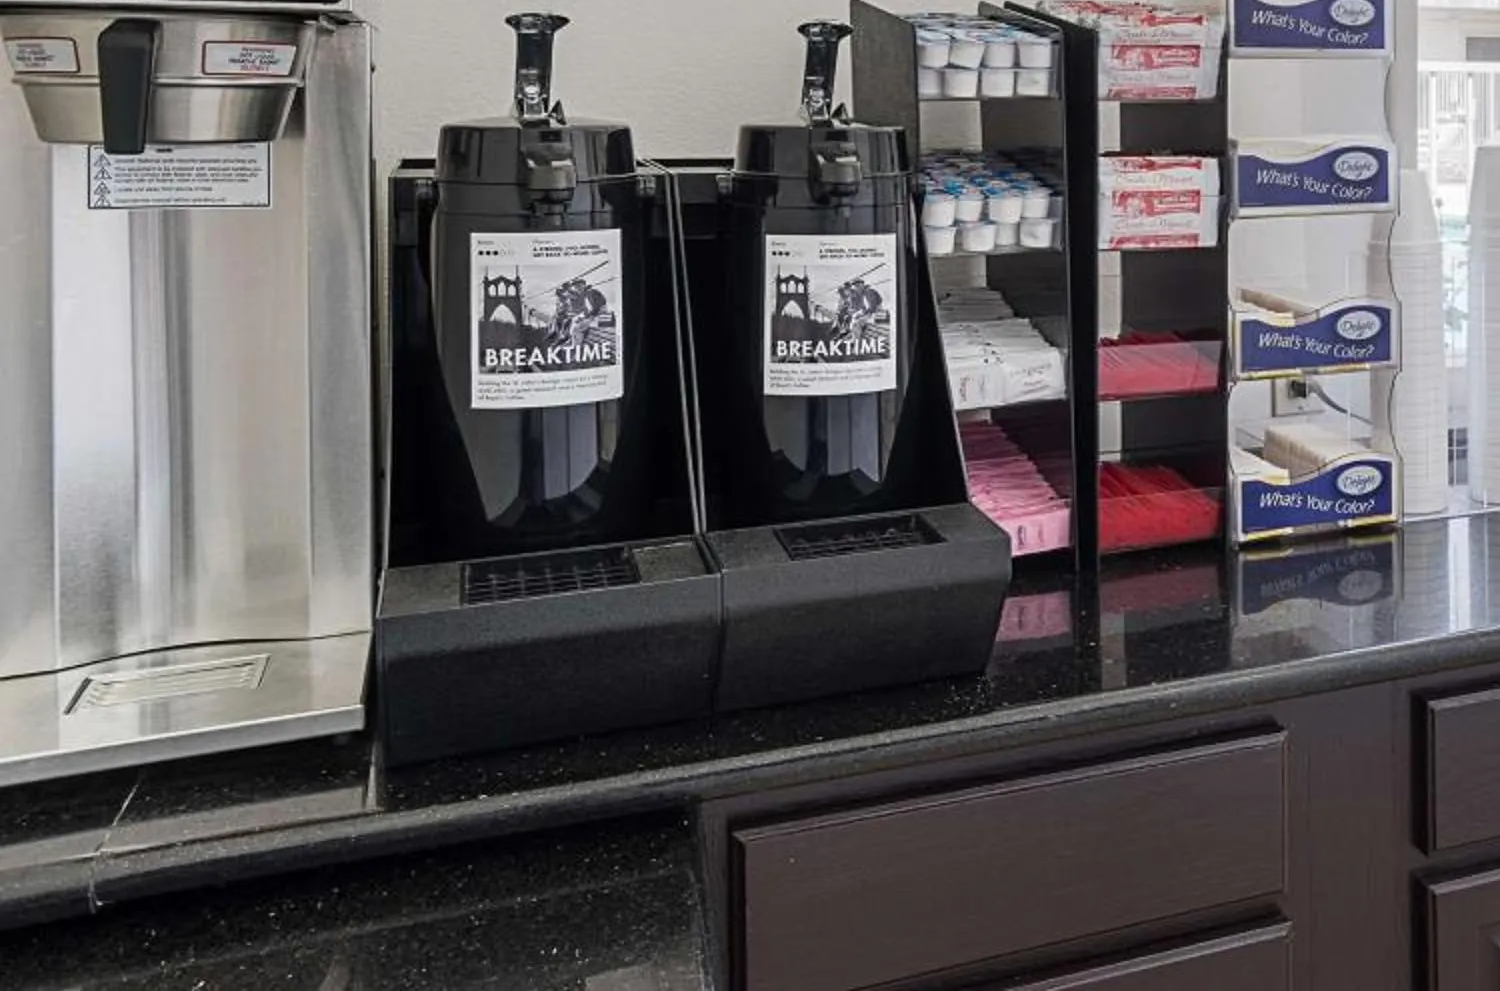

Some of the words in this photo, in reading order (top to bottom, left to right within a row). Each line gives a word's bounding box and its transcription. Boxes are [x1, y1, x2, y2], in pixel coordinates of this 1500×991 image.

[1251, 9, 1296, 30] What's
[1299, 18, 1326, 38] Your
[1327, 28, 1369, 46] Color?
[1256, 168, 1300, 188] What's
[1303, 176, 1330, 194] Your
[1331, 182, 1373, 200] Color?
[485, 342, 612, 367] BREAKTIME
[776, 336, 886, 357] BREAKTIME
[1258, 332, 1301, 351] What's
[1304, 336, 1332, 355] Your
[1333, 344, 1375, 359] Color?
[1259, 491, 1303, 508] What's
[1307, 494, 1334, 511] Your
[1335, 498, 1376, 514] Color?
